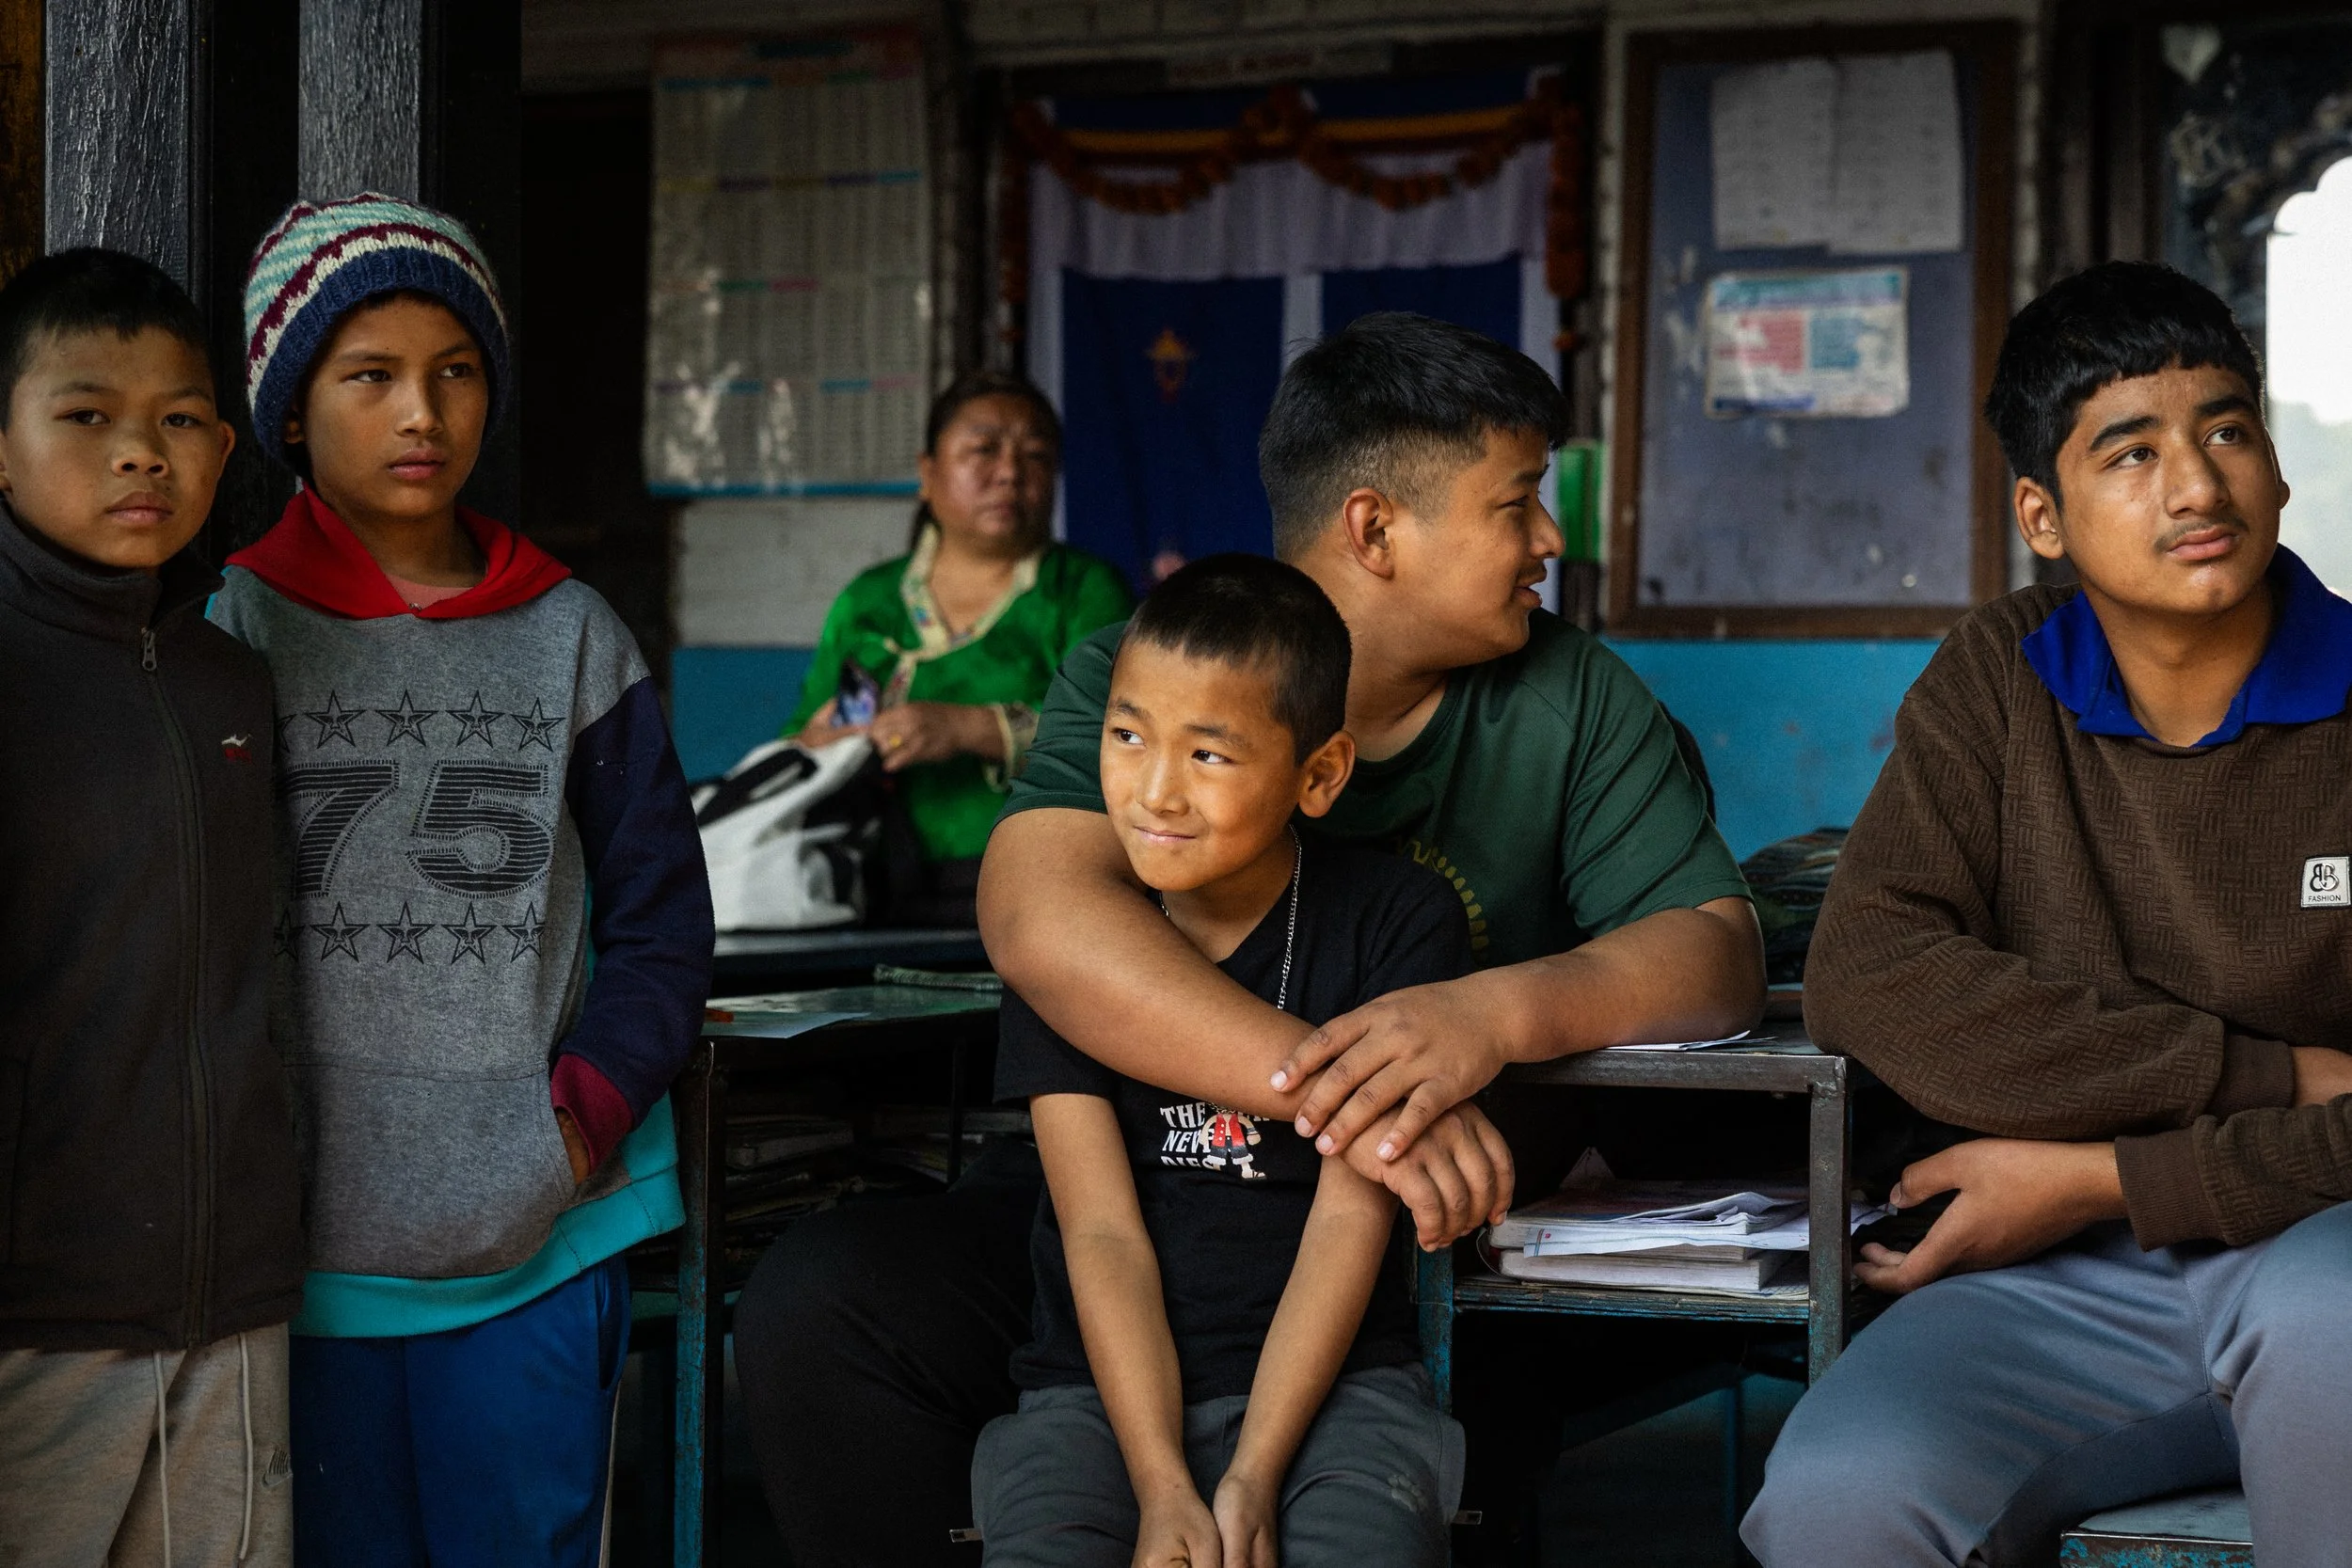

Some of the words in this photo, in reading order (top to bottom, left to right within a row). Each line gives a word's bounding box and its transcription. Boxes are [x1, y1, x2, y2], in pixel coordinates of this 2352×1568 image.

[278, 758, 556, 899] 75
[2308, 895, 2342, 903] FASHION
[1159, 1101, 1205, 1128] THE
